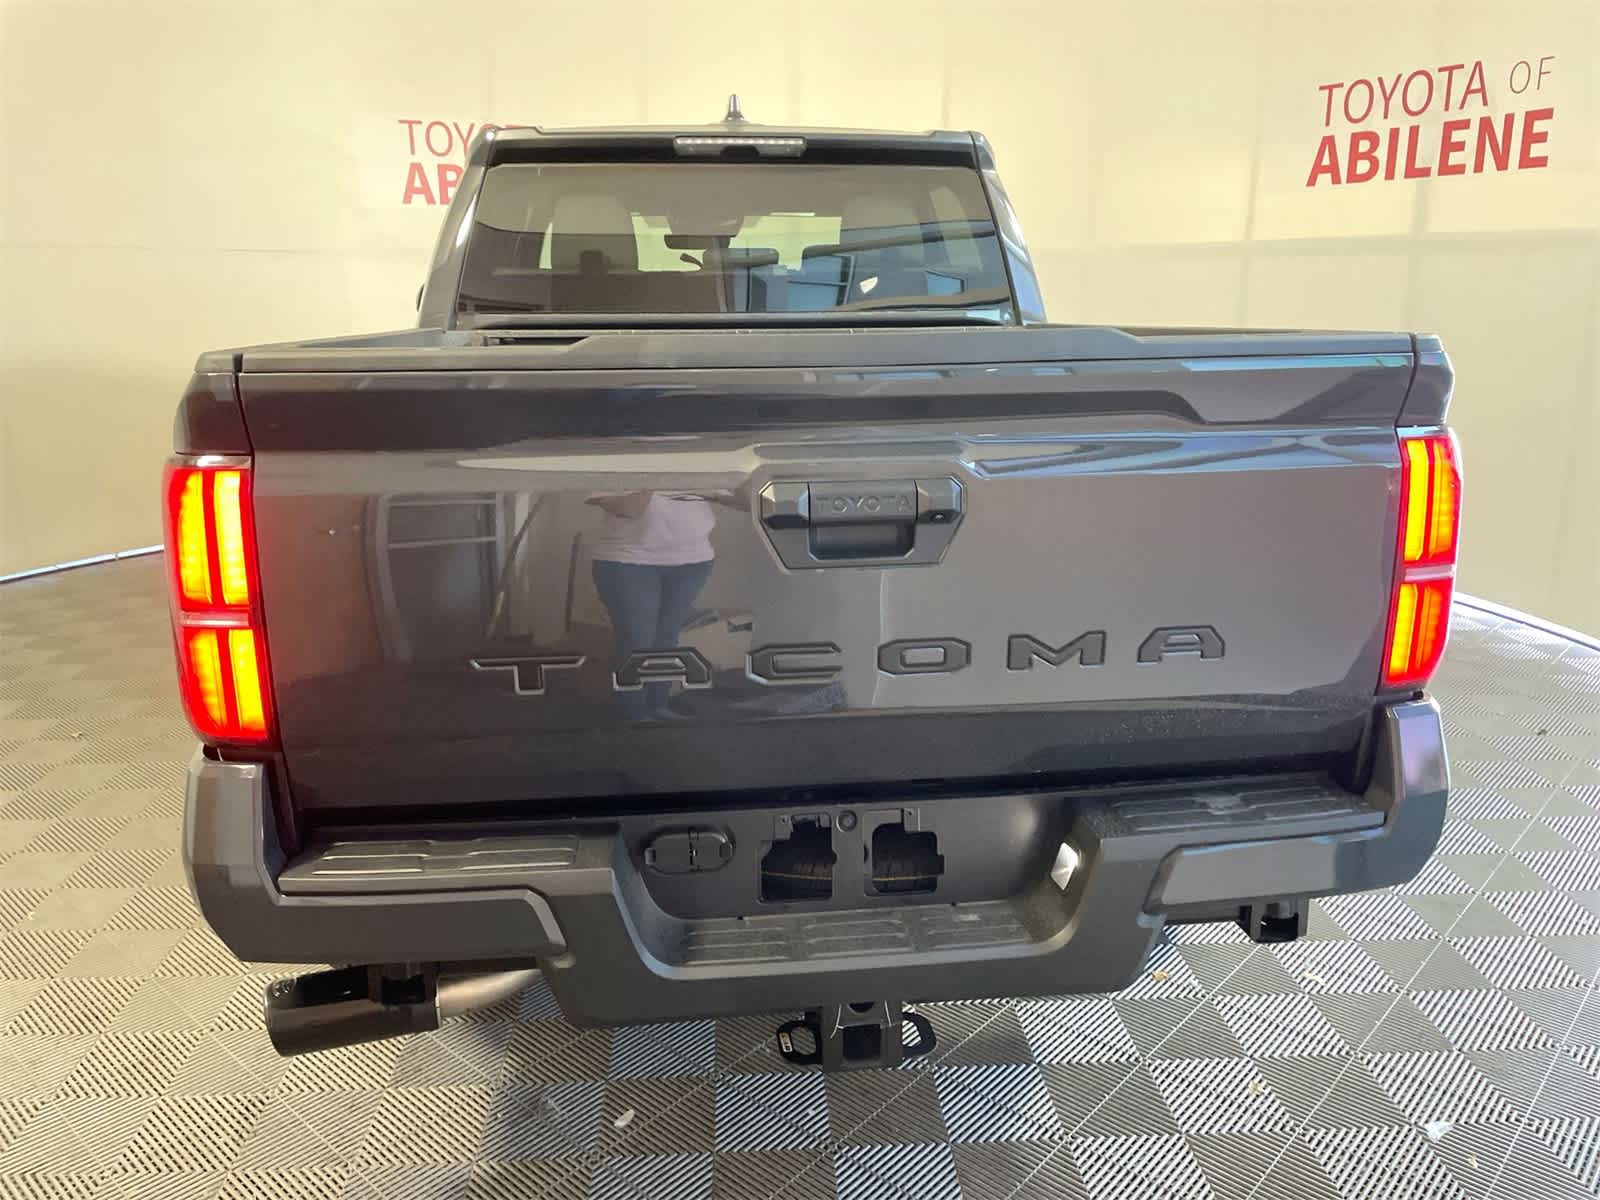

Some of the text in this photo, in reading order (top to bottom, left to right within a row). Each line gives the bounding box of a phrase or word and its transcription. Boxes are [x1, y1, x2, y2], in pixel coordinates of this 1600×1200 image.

[1318, 55, 1555, 127] TOYOTA OF
[398, 119, 523, 157] TOY
[1305, 107, 1554, 187] ABILENE
[815, 495, 911, 513] TOYOTA
[470, 625, 1225, 696] TACOMA
